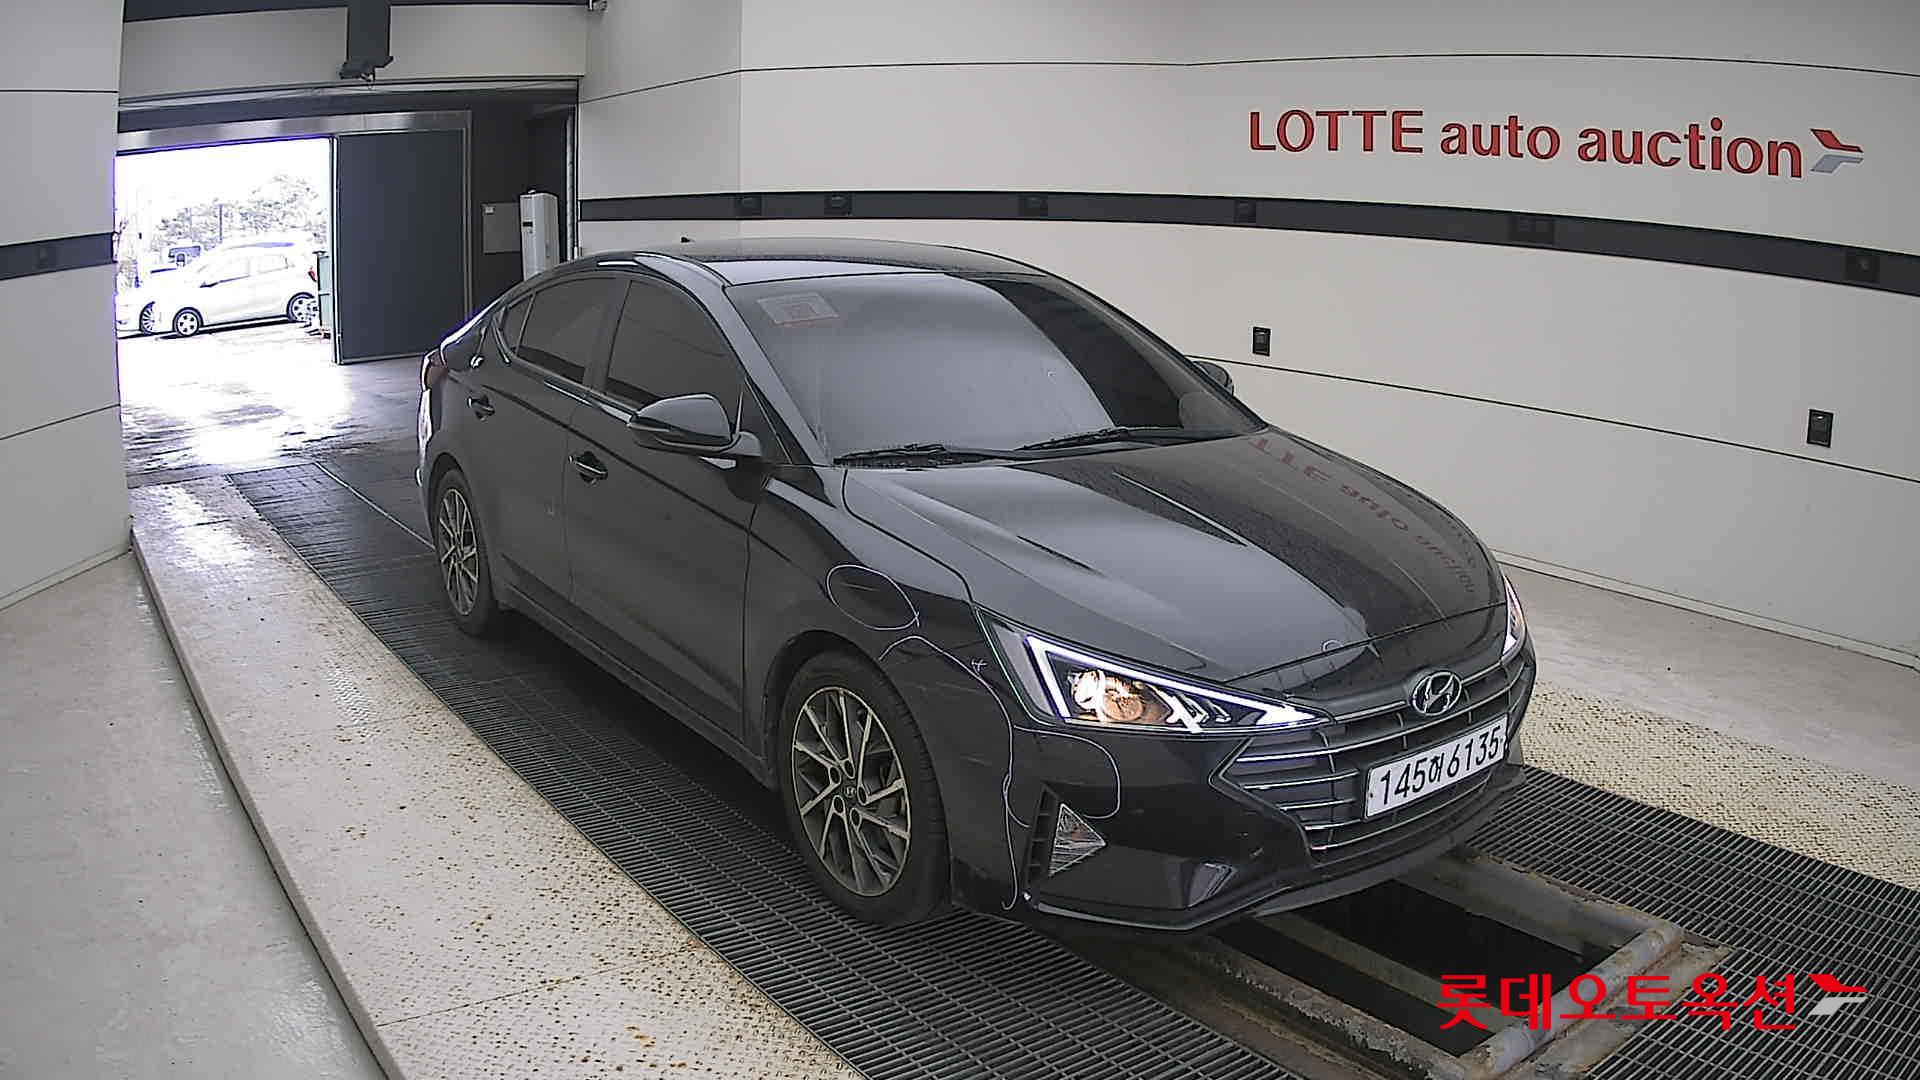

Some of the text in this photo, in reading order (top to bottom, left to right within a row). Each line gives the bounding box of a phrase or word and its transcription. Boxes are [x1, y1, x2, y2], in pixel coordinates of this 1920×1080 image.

[1249, 109, 1803, 179] LOTTE auto auction
